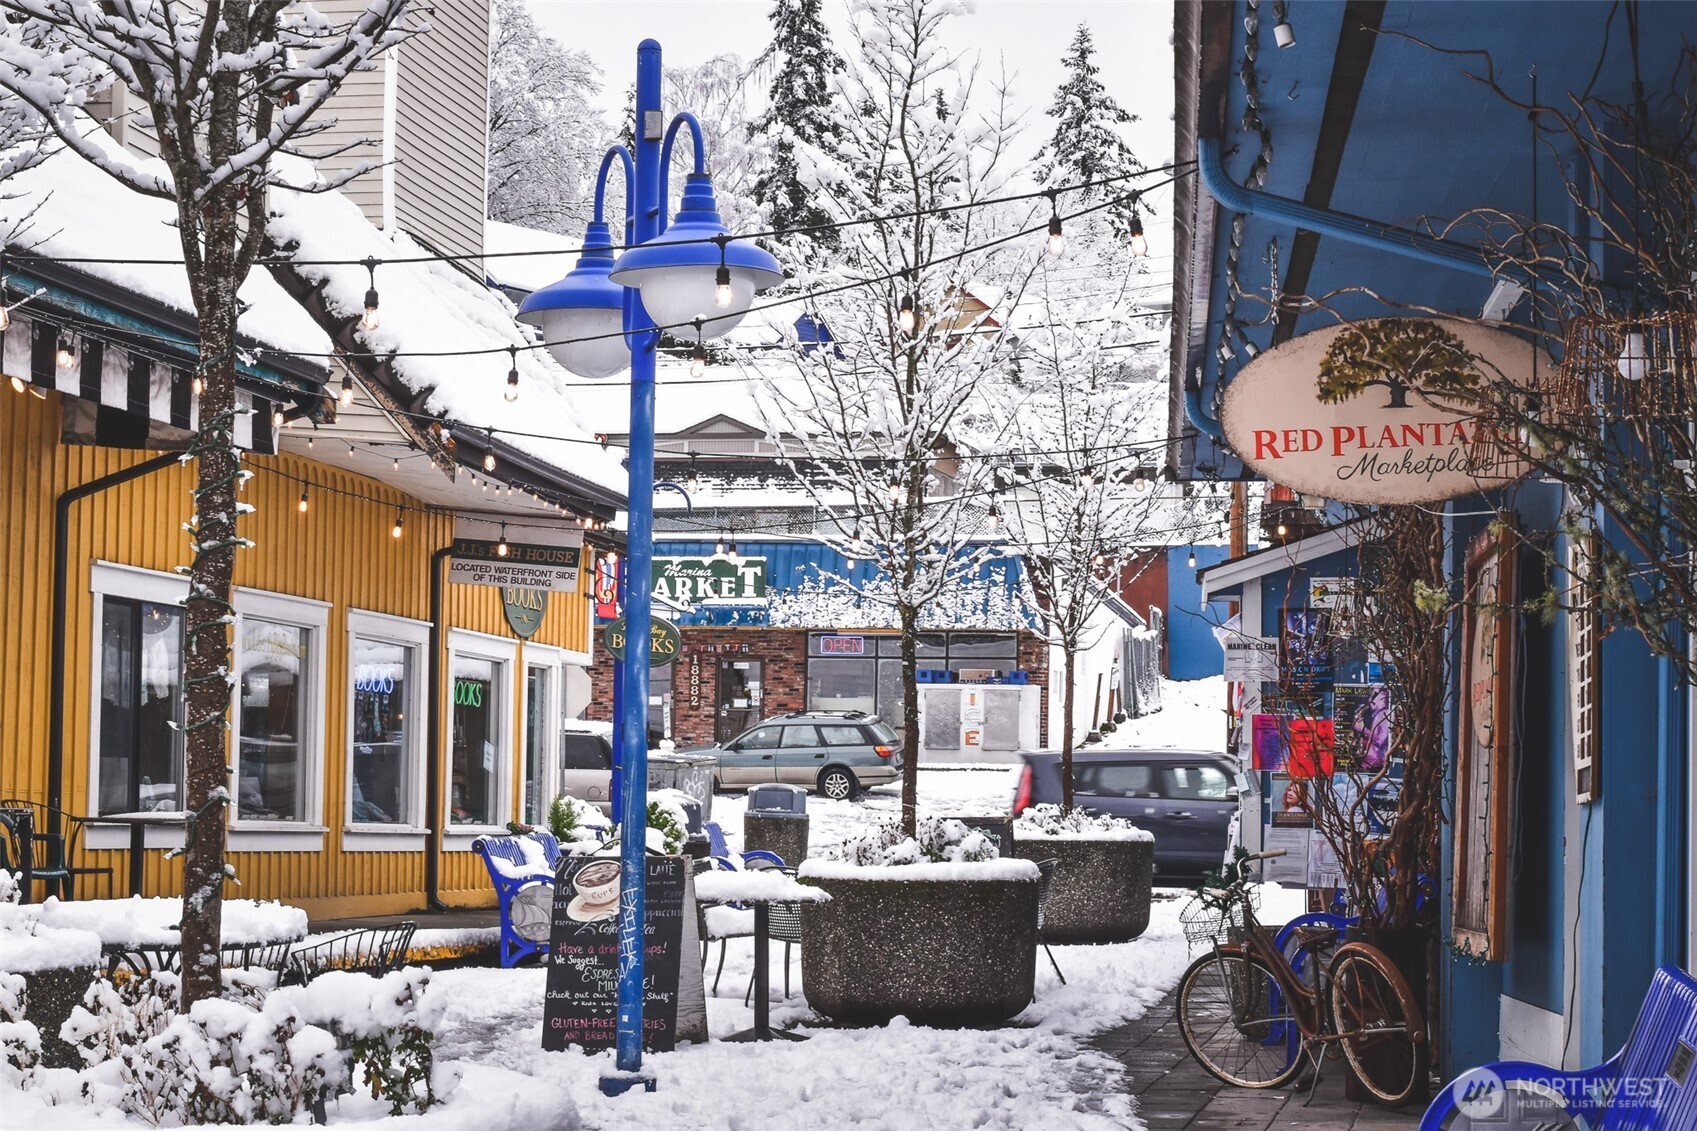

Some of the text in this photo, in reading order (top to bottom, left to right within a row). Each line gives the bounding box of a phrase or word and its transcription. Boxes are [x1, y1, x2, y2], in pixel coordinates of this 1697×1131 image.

[1253, 430, 1323, 460] RED
[525, 548, 574, 563] HOUSE
[451, 562, 576, 580] LOCATED WATERFRONT SIDE
[664, 564, 713, 578] Marina
[472, 573, 552, 587] OF THIS BUILDING
[653, 566, 762, 598] ARKET
[506, 587, 543, 613] BOOKS
[611, 633, 674, 654] BKS
[821, 637, 864, 653] OPEN
[356, 664, 395, 694] BOOKS
[691, 655, 700, 706] 18882
[454, 680, 483, 708] OOKS
[558, 942, 584, 955] Have
[588, 946, 595, 954] a
[574, 991, 590, 999] out
[551, 1017, 616, 1029] GLUTEN-FREE
[563, 1031, 615, 1040] AND BREAD
